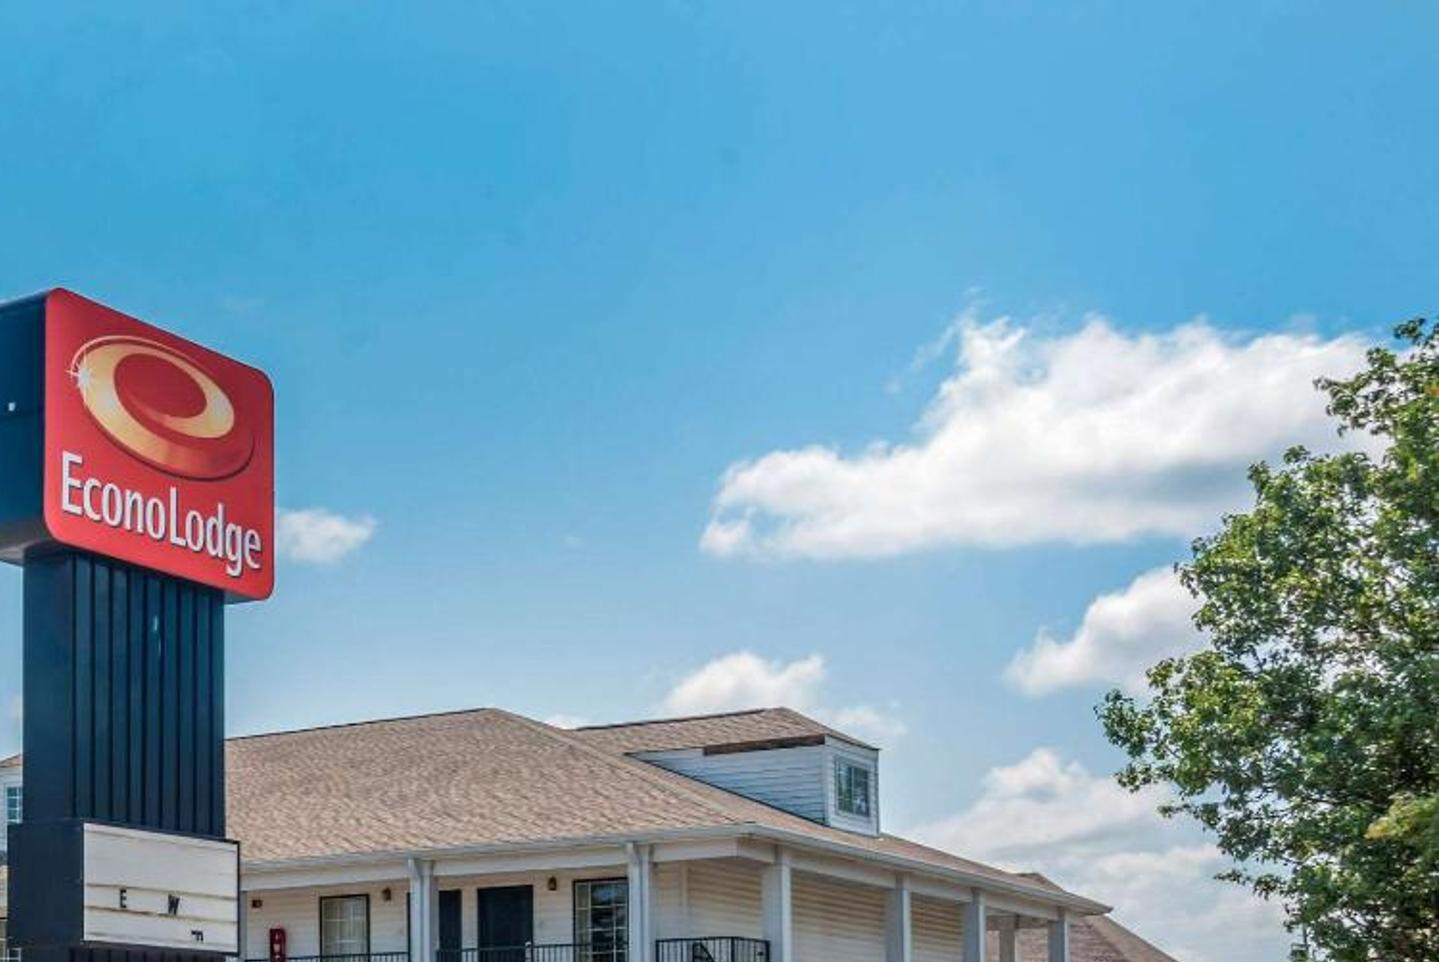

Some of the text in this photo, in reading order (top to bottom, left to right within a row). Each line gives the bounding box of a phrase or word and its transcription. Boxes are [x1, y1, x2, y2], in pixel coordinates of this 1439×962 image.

[62, 451, 261, 577] EconoLodge
[120, 889, 180, 914] E W
